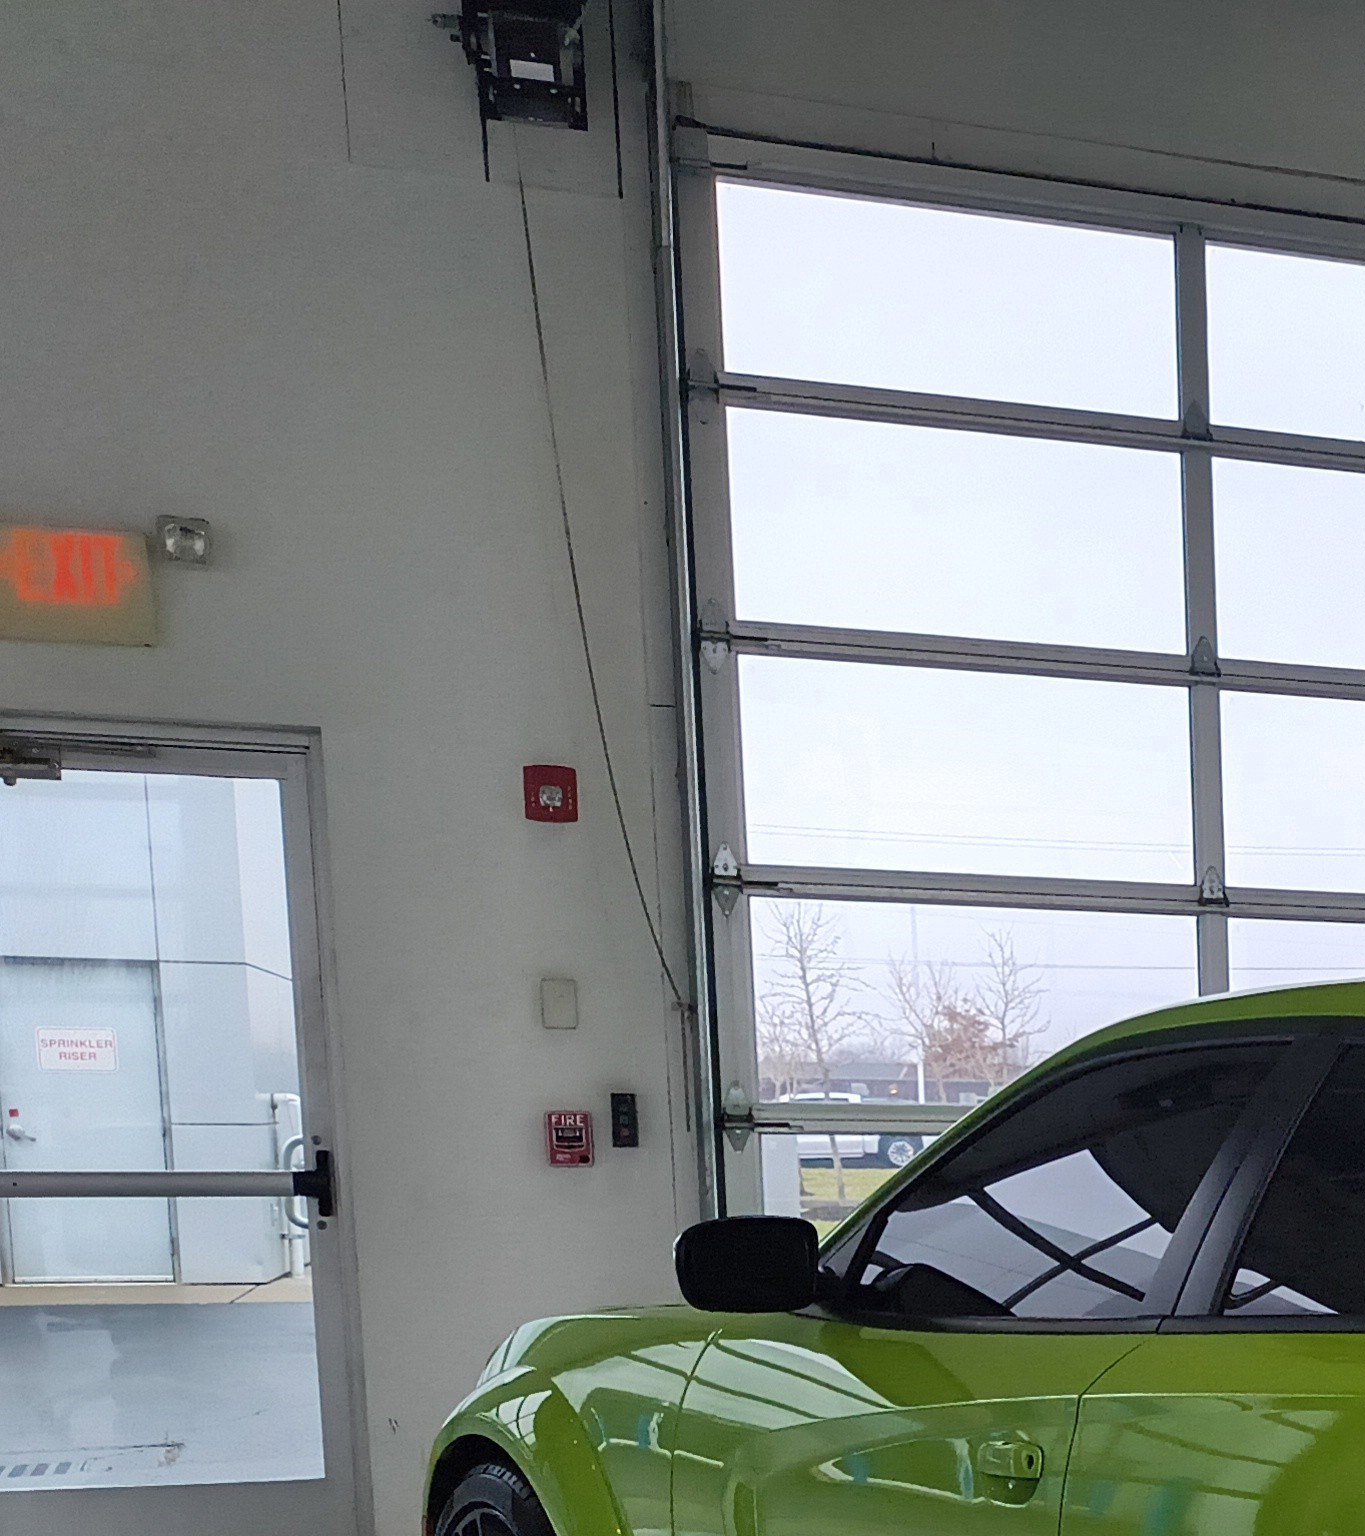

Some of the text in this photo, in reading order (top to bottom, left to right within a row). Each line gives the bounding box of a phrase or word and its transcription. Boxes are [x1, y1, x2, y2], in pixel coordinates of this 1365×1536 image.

[14, 529, 121, 605] EXIT
[40, 1038, 114, 1049] SPRINKLER
[58, 1051, 97, 1061] RISER
[551, 1114, 584, 1126] FIRE
